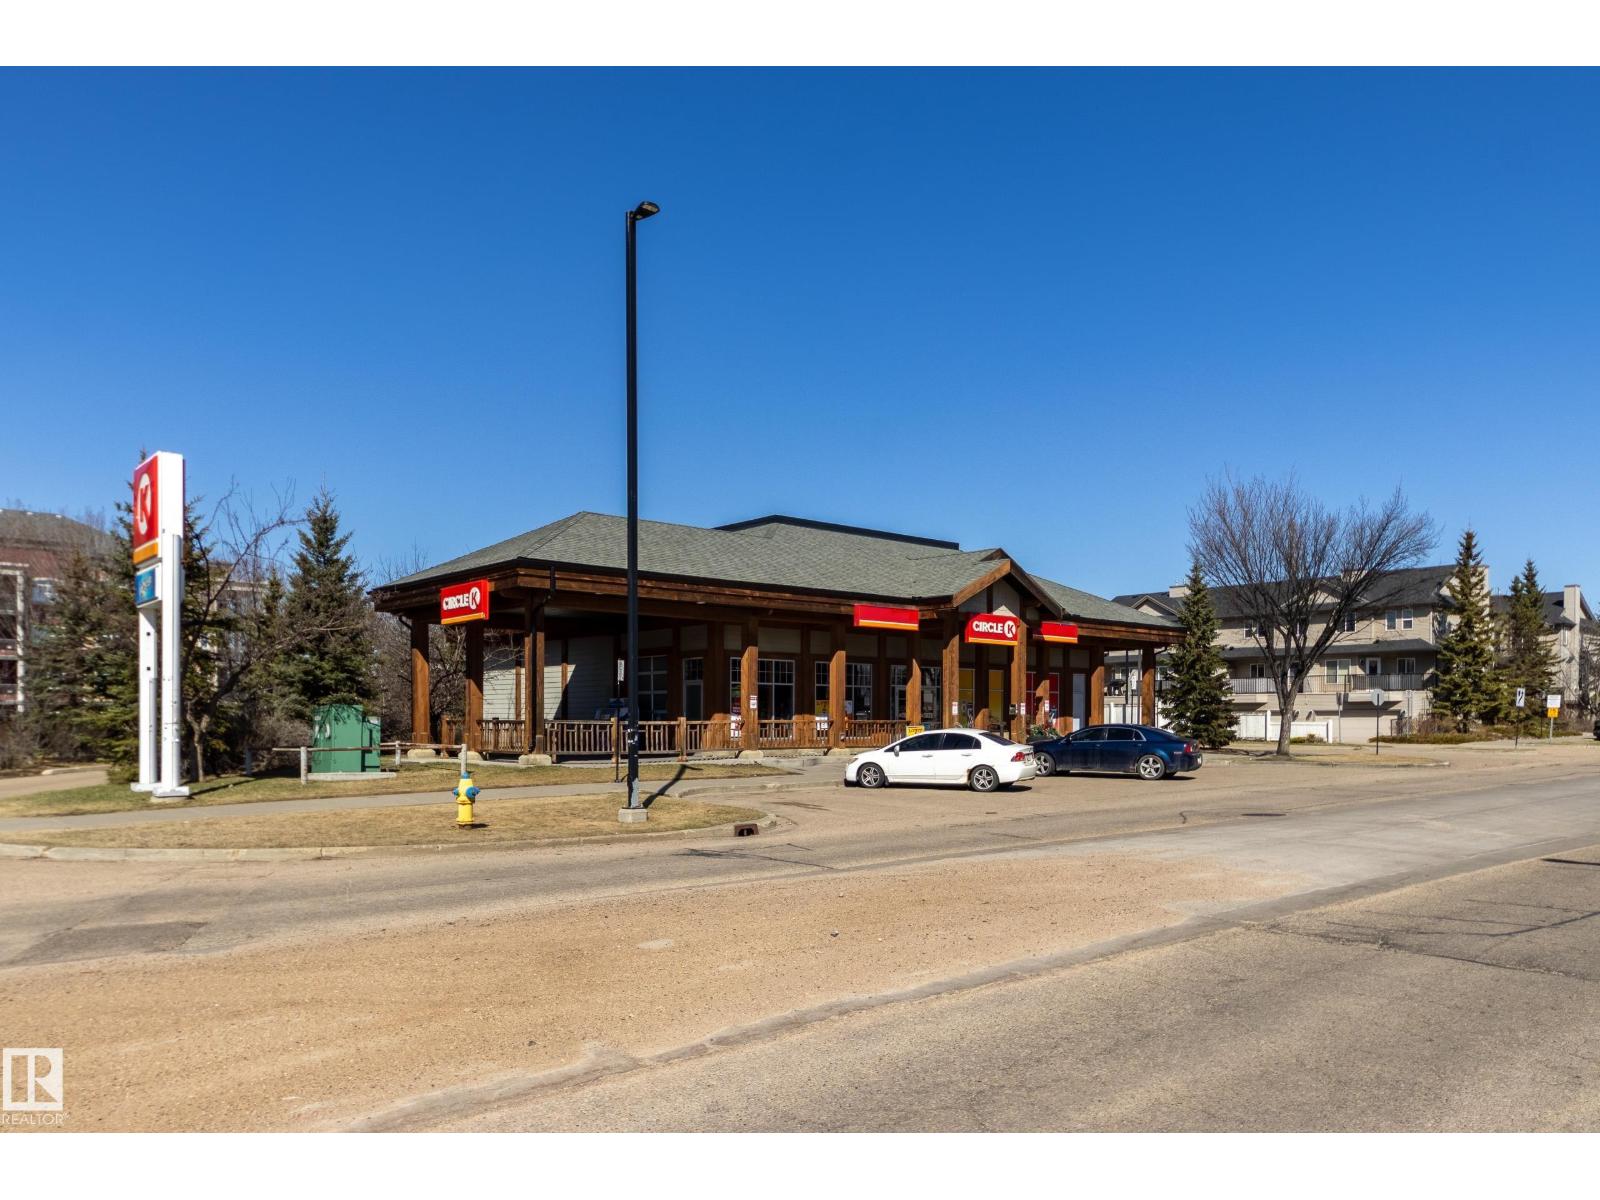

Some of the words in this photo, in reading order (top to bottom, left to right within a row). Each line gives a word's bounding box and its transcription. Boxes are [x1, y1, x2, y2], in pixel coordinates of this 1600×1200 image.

[139, 481, 151, 529] K
[443, 594, 469, 610] CIRCLE
[972, 620, 1003, 634] CIRCLE
[1004, 621, 1015, 637] K
